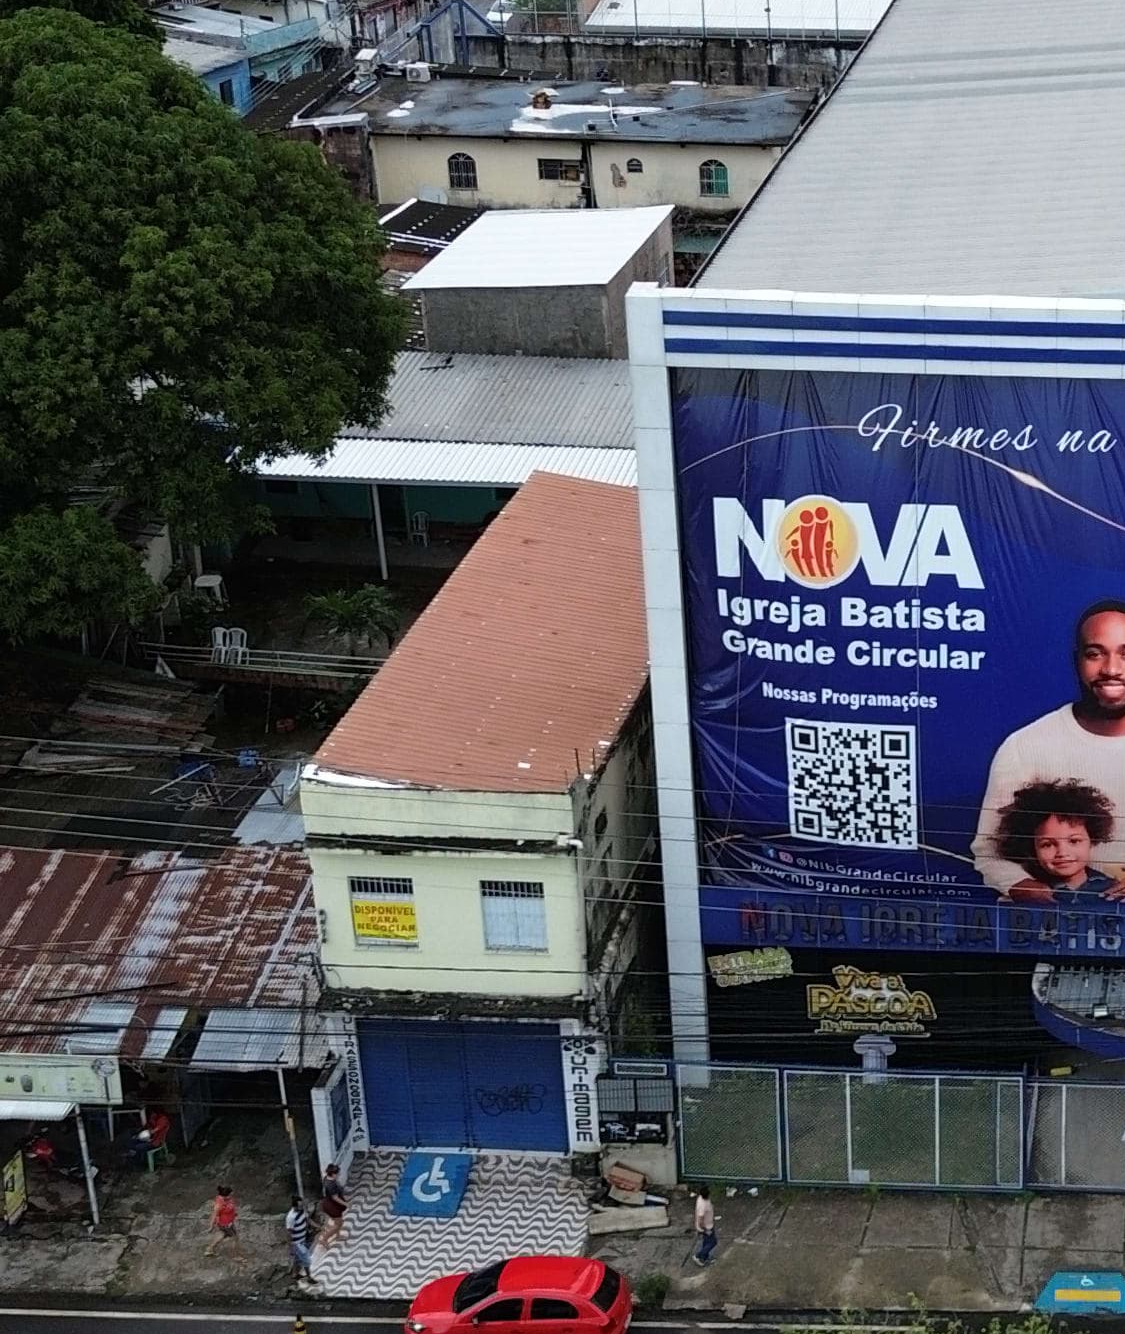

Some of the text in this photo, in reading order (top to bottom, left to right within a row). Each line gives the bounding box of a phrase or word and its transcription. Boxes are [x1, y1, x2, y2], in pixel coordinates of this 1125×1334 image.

[858, 403, 1038, 453] Firmes
[1057, 426, 1117, 453] na
[713, 495, 985, 589] NOVA
[717, 588, 985, 632] Igreja Batista
[722, 629, 985, 670] Grande Circular
[762, 681, 938, 711] Nossas Programações
[861, 904, 994, 947] IGREJA
